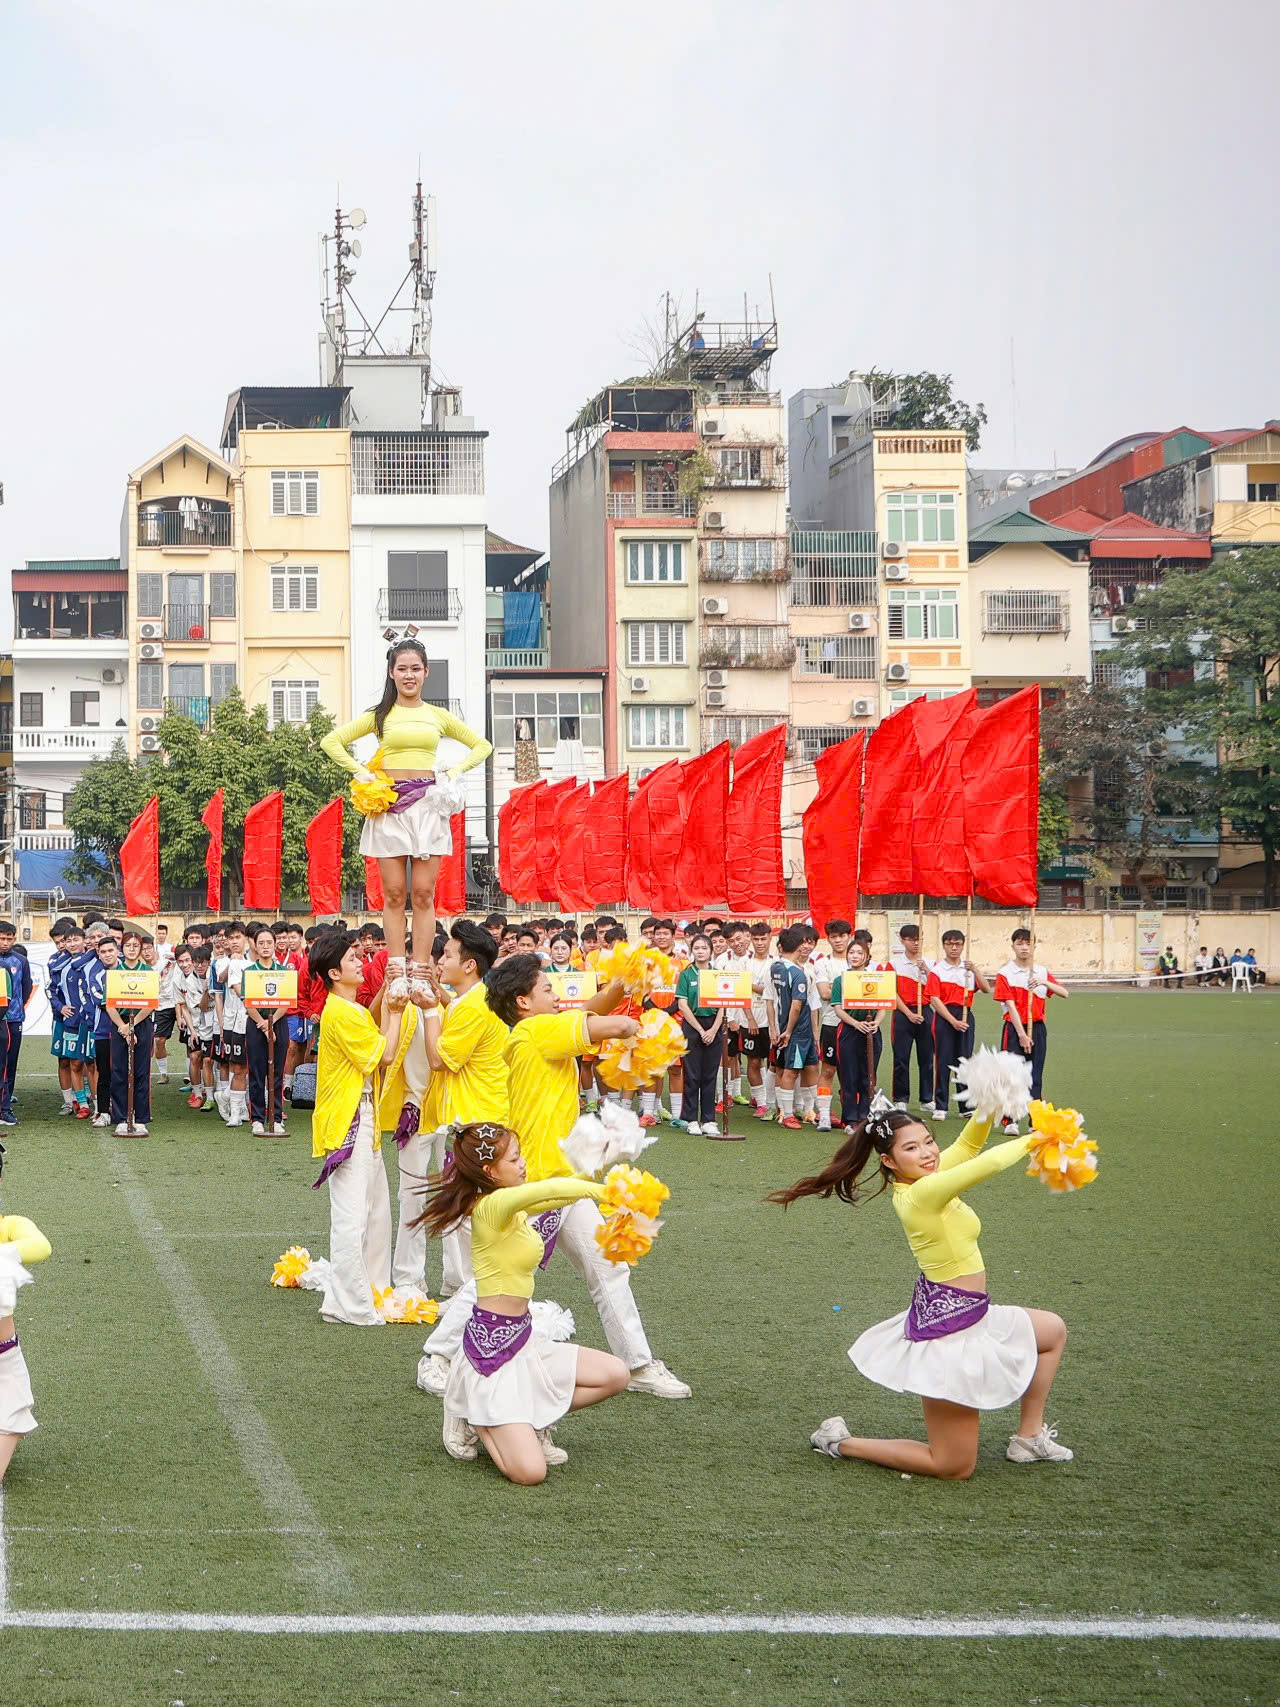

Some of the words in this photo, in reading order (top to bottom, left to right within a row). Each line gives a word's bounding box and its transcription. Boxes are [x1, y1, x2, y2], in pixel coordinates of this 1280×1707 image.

[54, 1040, 60, 1049] 6
[68, 1040, 76, 1052] 10
[234, 1044, 241, 1055] 13
[744, 1039, 754, 1050] 20
[826, 1047, 834, 1058] 3
